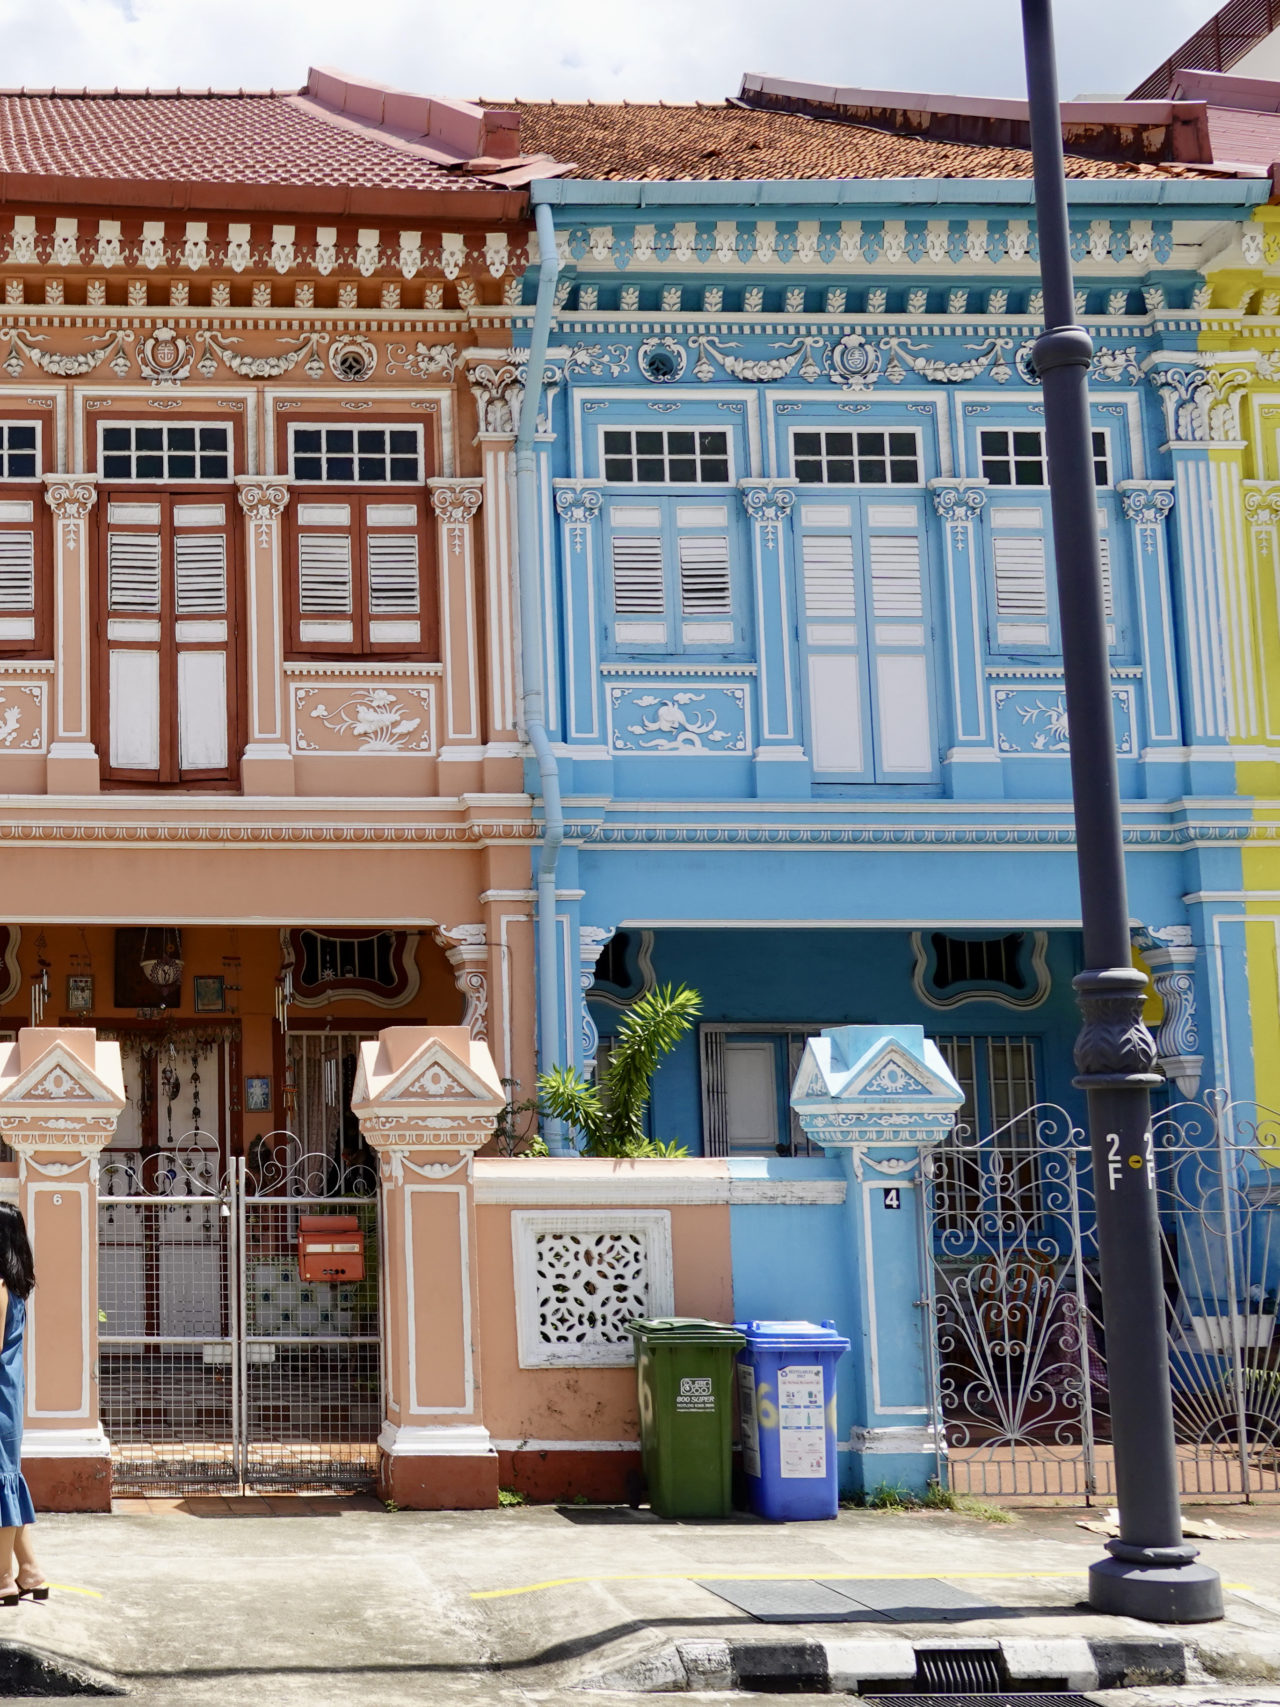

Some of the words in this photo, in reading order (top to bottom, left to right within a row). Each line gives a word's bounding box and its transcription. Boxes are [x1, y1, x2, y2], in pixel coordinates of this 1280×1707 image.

[53, 1194, 63, 1206] 6
[885, 1189, 899, 1208] 4
[756, 1382, 779, 1429] 6
